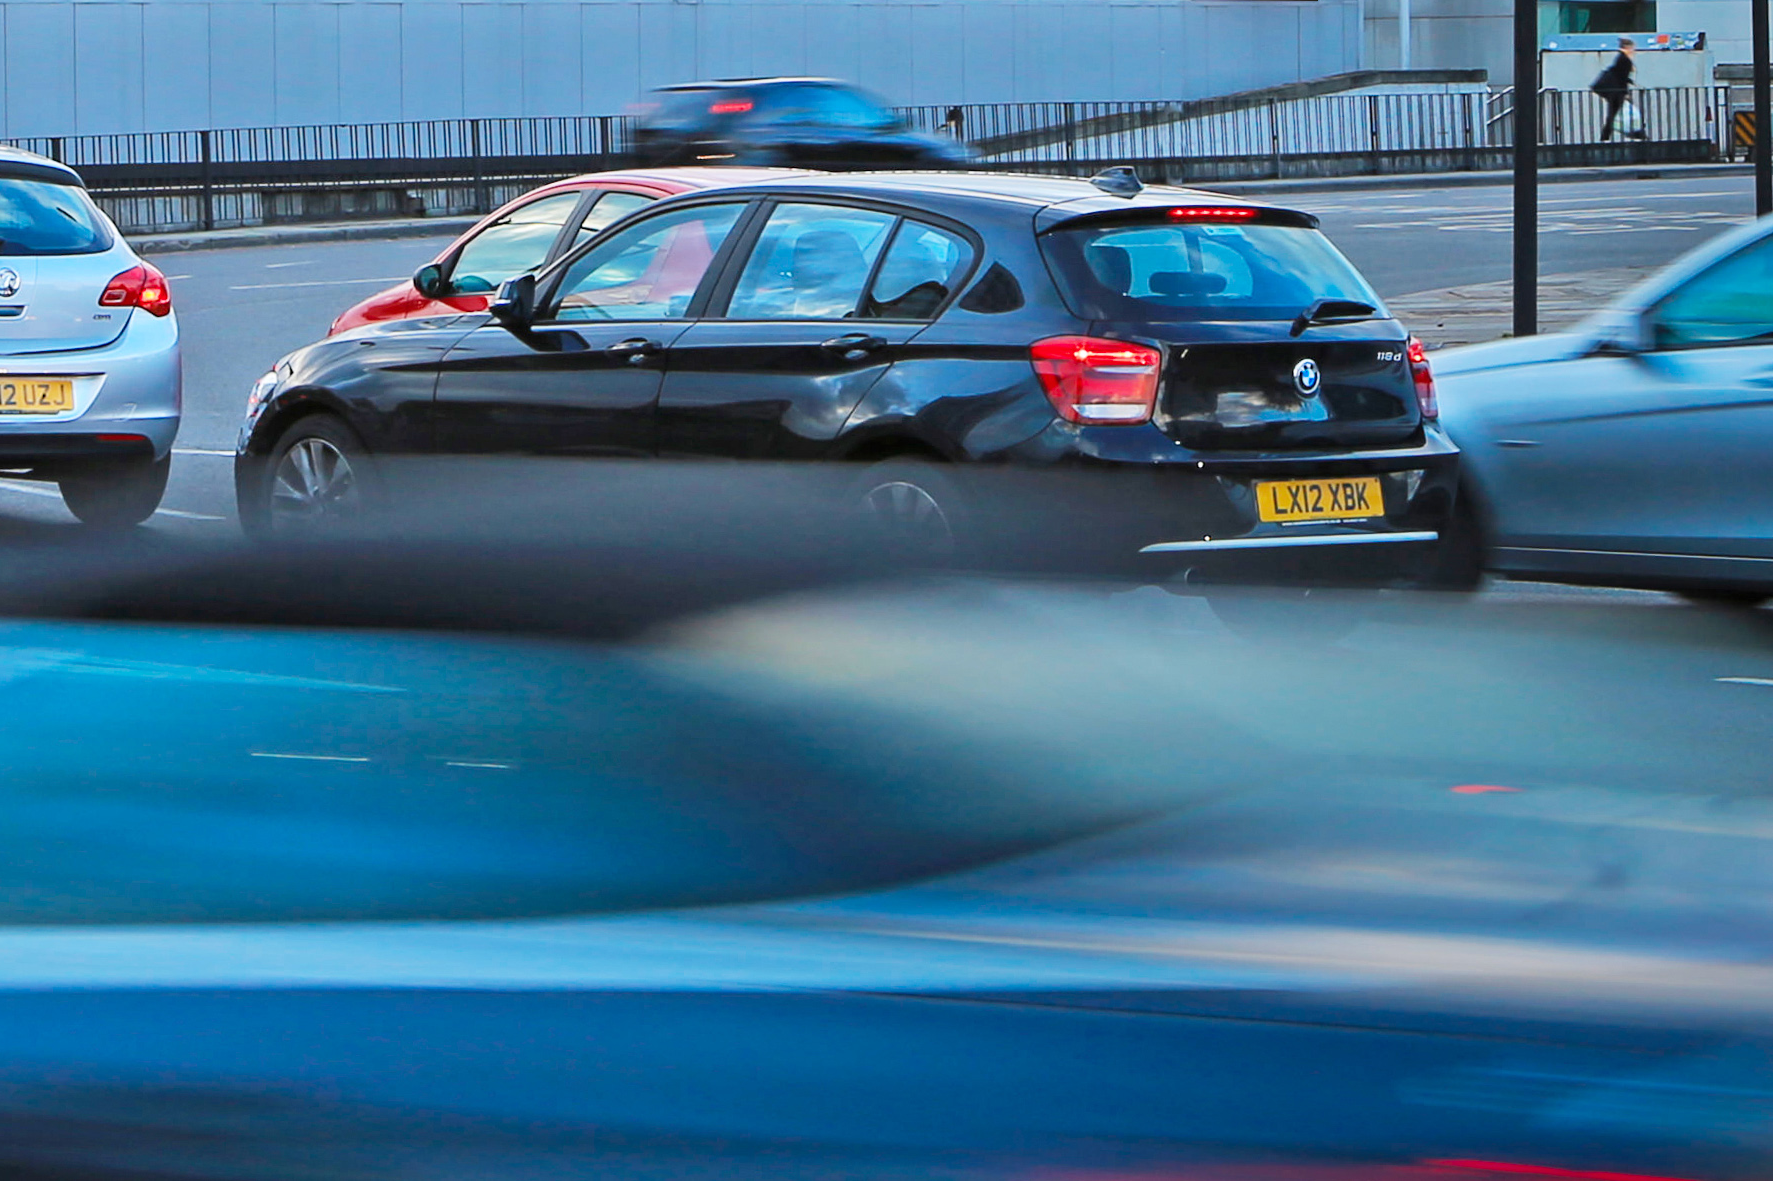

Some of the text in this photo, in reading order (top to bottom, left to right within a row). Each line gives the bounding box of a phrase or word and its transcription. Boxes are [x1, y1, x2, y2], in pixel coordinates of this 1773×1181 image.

[1377, 351, 1402, 362] 118d
[23, 384, 65, 406] UZJ
[1272, 482, 1370, 515] LX12 XBK
